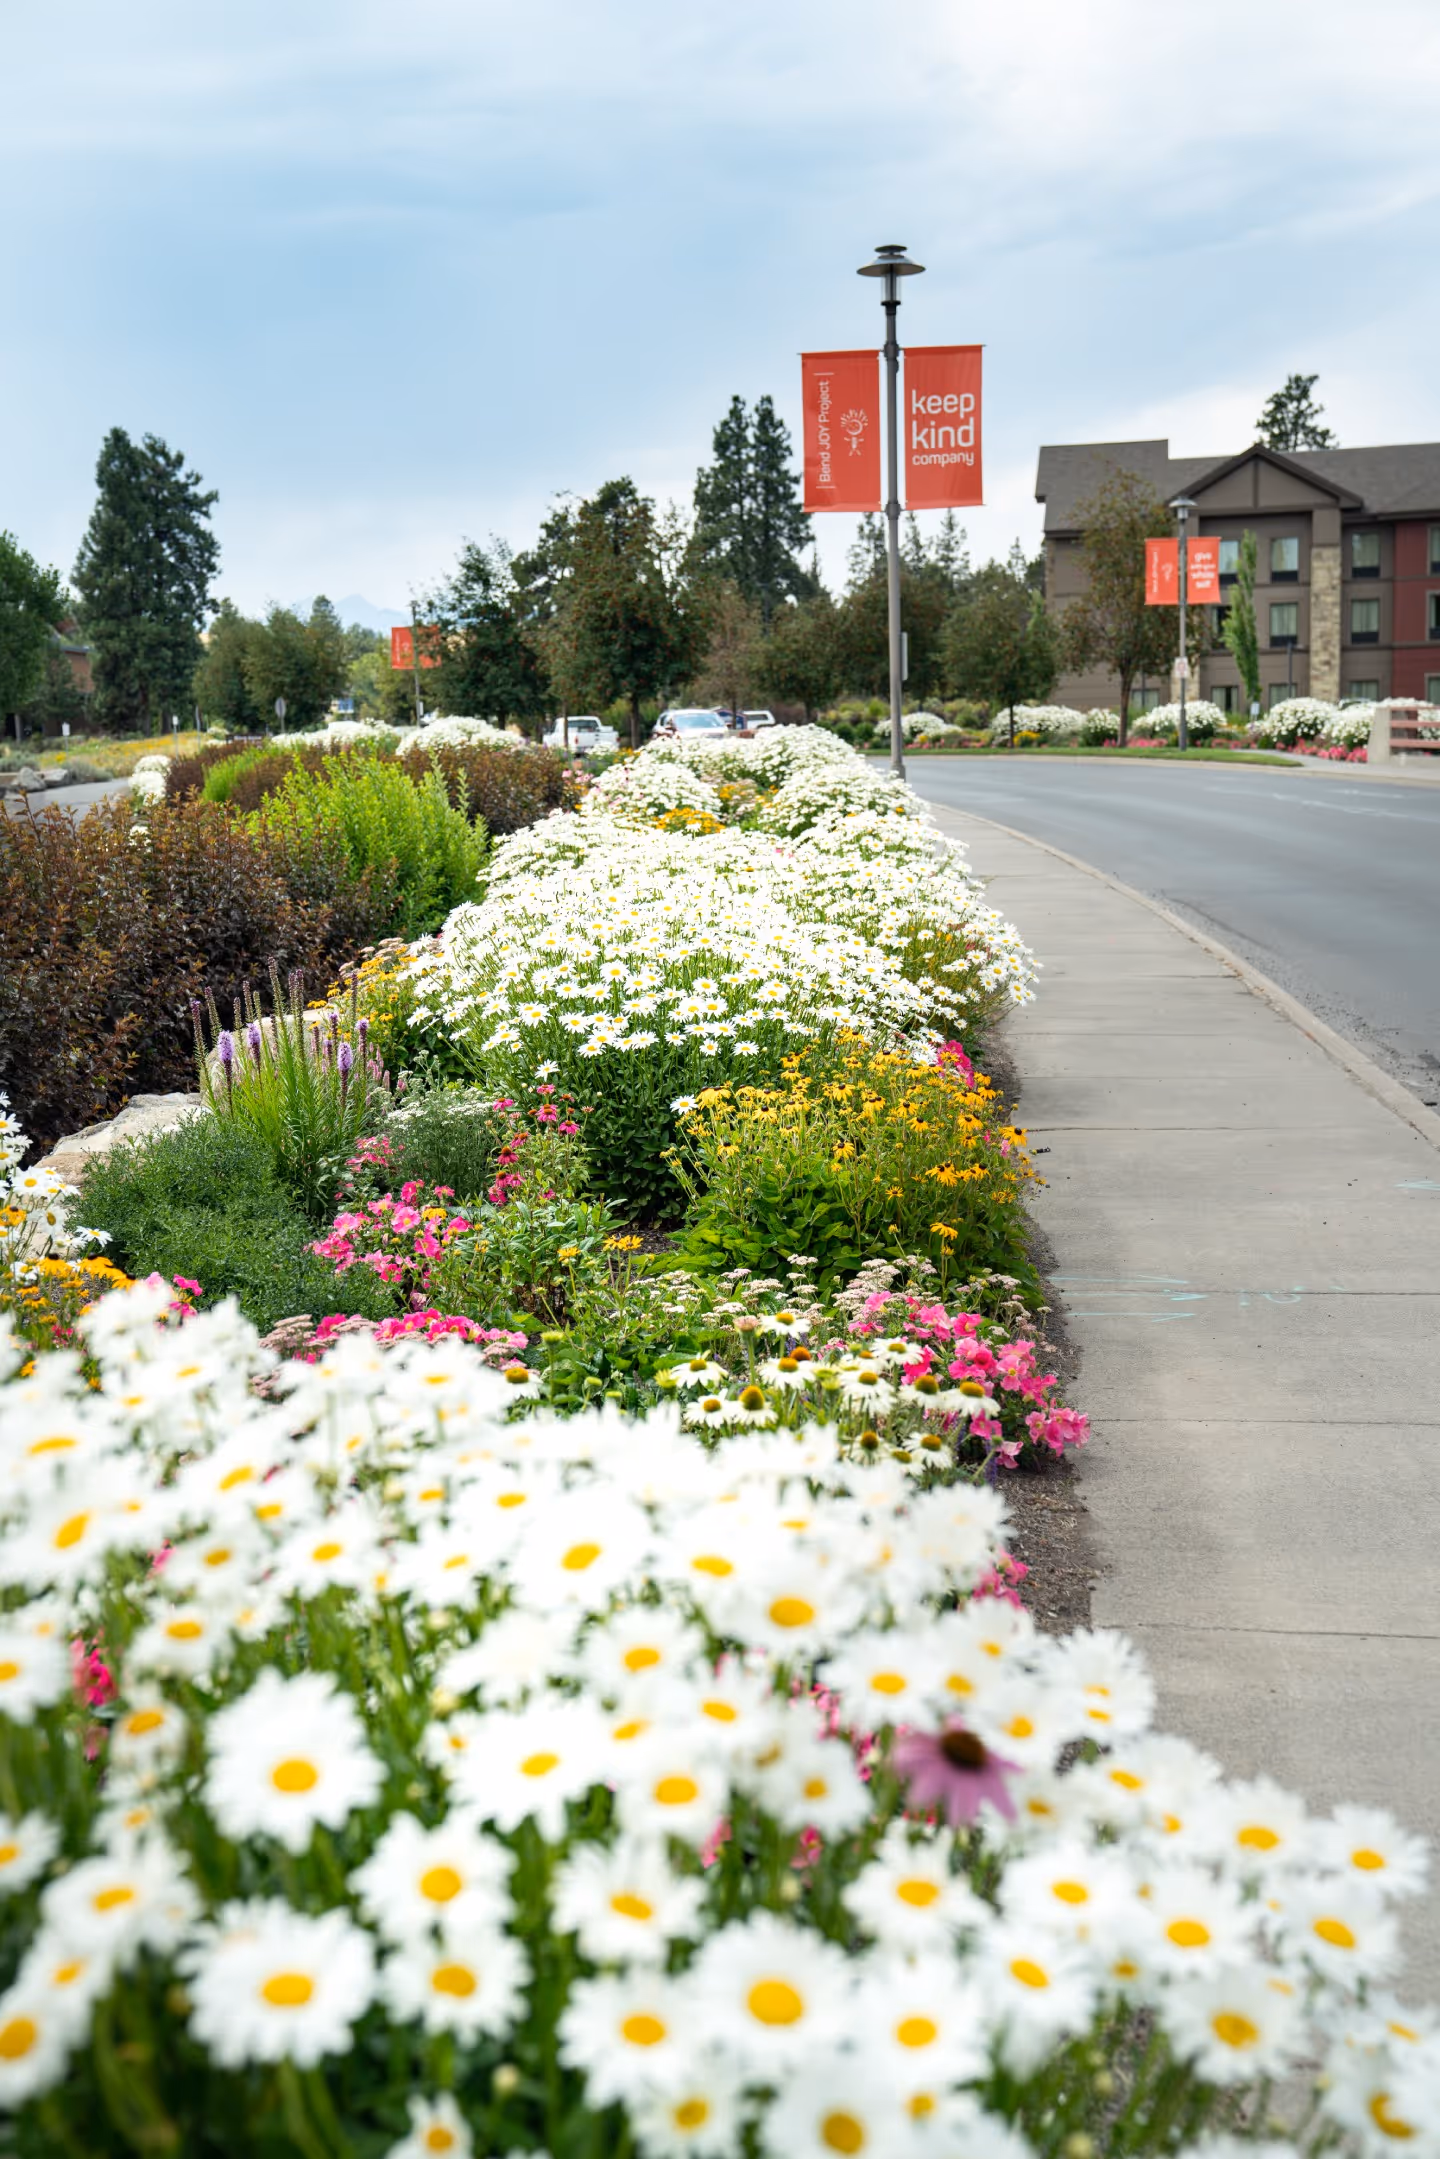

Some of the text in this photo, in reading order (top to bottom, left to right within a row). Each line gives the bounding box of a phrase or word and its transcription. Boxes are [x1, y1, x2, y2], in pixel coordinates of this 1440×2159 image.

[912, 389, 975, 419] keep
[818, 380, 832, 482] Bend JOY Project
[912, 416, 975, 449] kind
[912, 452, 975, 468] company
